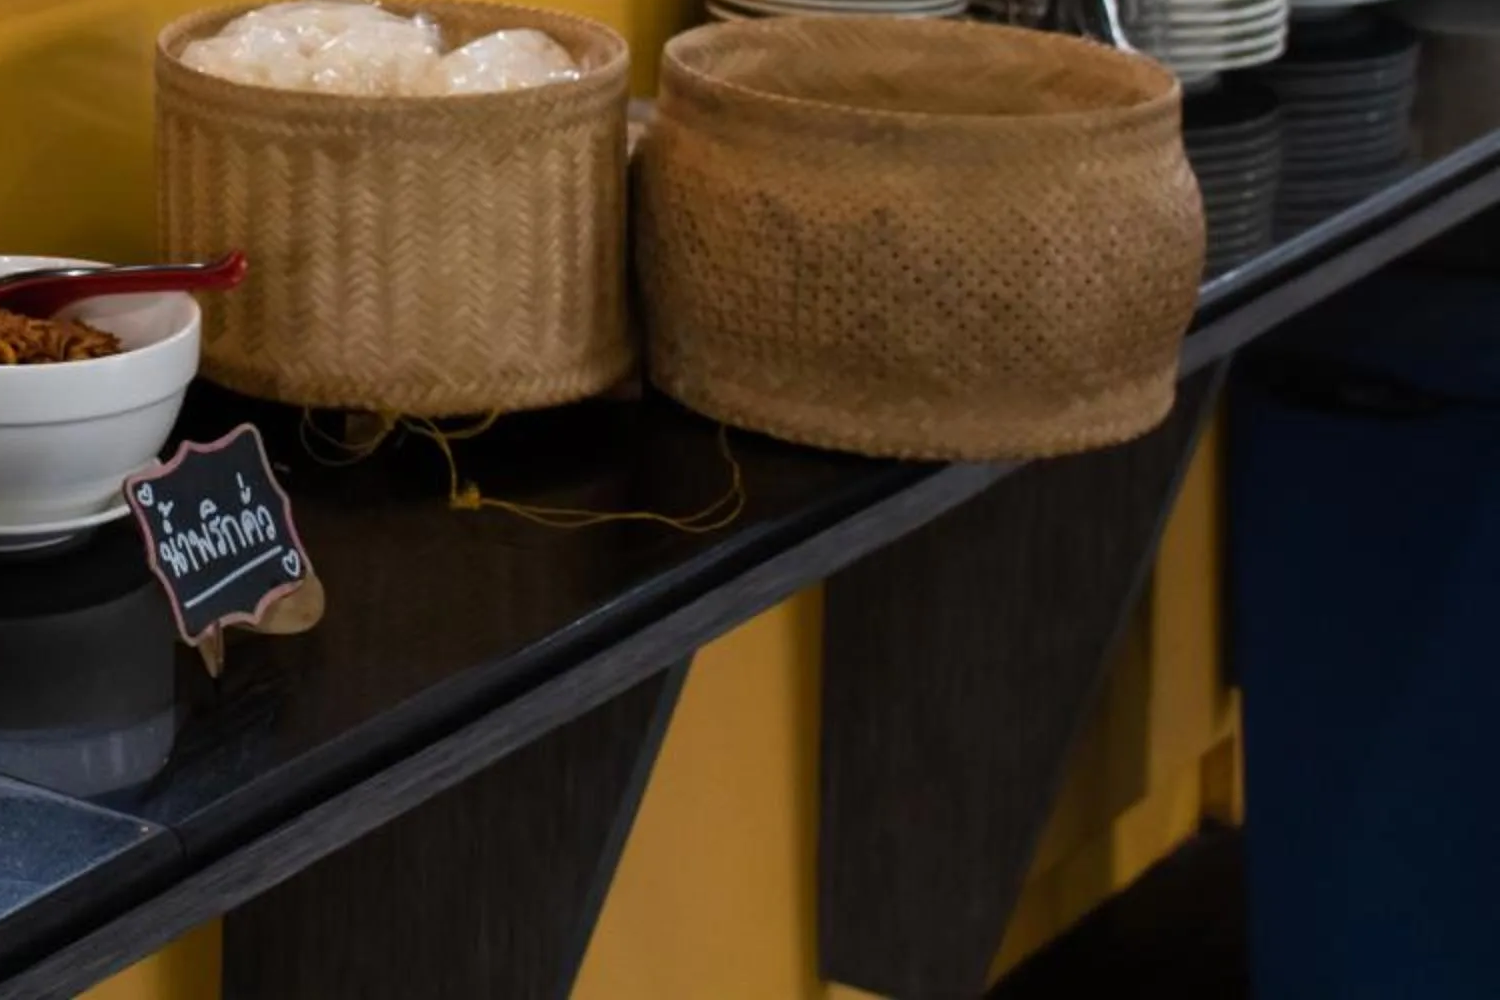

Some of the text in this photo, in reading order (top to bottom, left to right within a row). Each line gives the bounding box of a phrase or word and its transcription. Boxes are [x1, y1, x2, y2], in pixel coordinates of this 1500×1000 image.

[157, 471, 278, 579] น้ำพริกคั่ว
